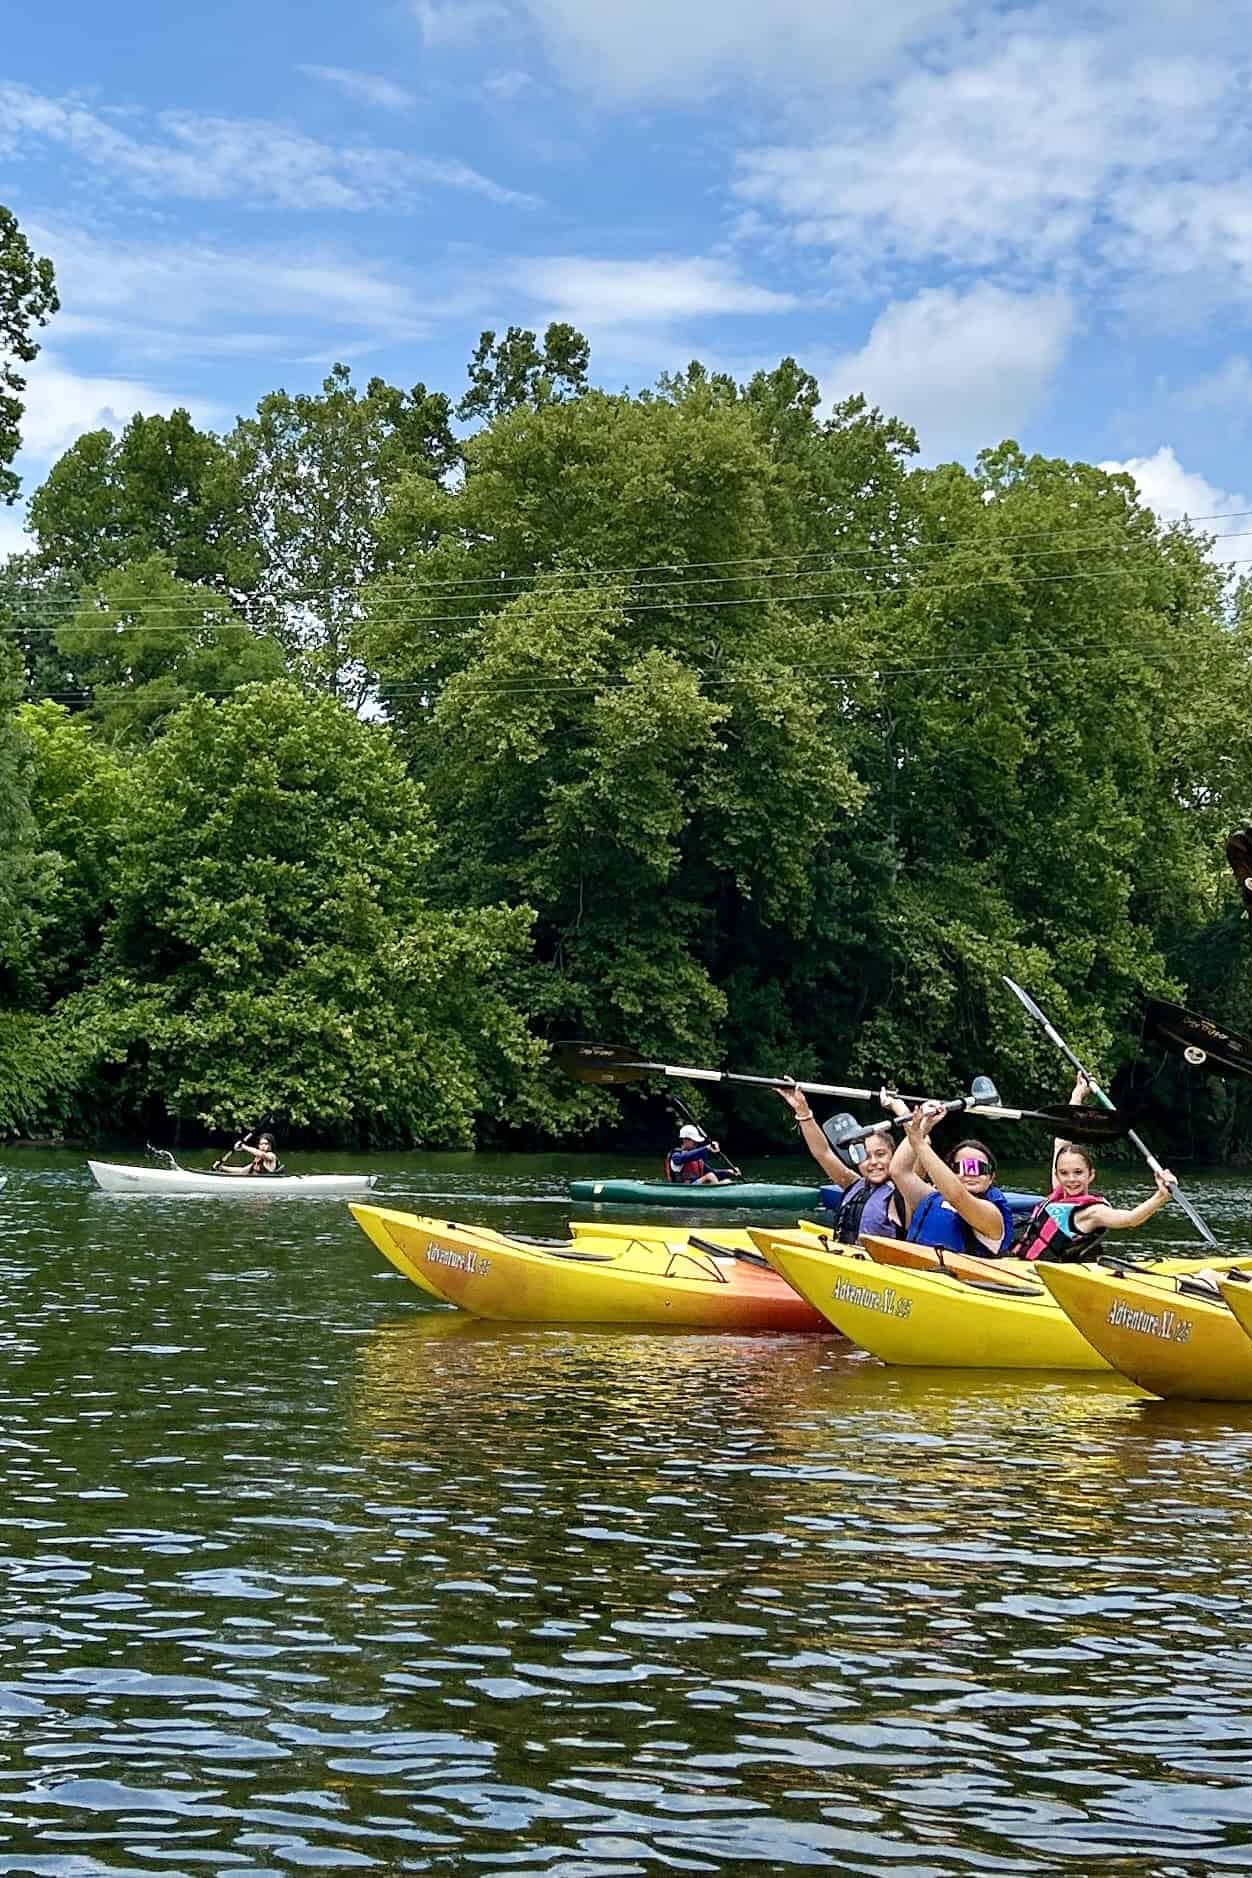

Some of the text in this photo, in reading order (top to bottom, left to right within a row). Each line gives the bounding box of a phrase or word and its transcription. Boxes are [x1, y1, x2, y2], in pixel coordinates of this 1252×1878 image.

[426, 1240, 465, 1270] Adventure
[832, 1275, 880, 1310] Adventure
[1106, 1297, 1159, 1335] Adventure
